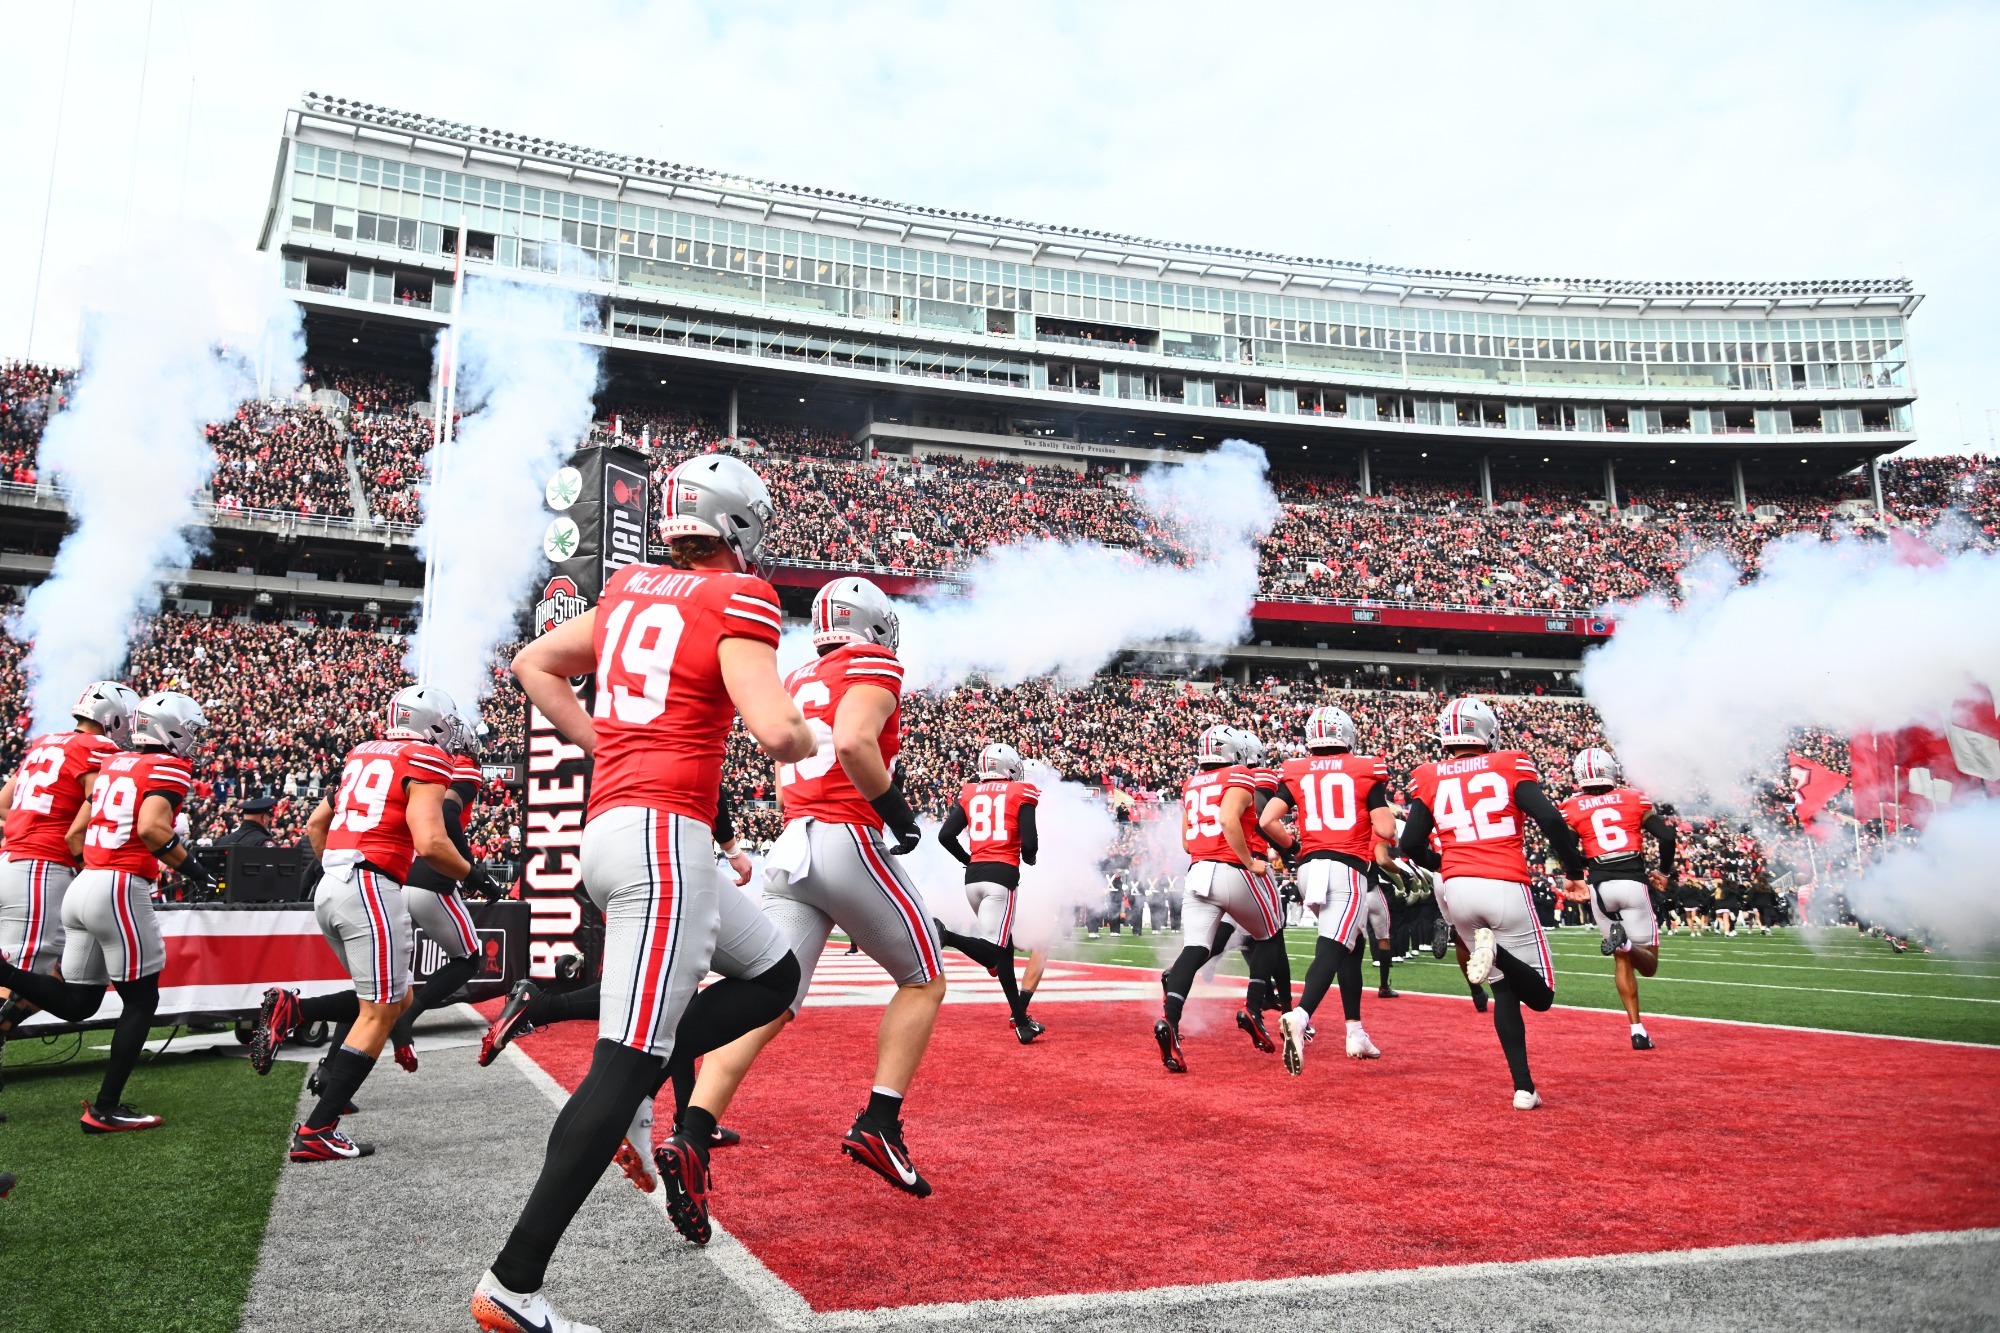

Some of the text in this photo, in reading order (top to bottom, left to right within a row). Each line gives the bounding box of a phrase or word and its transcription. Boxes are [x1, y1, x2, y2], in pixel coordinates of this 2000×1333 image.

[1023, 439, 1116, 454] The Shelly Family Pressbox
[603, 509, 642, 571] ber
[623, 571, 708, 597] McLARTY
[535, 600, 555, 637] OHIO
[593, 600, 686, 725] 19
[11, 746, 66, 815] 62
[975, 782, 1009, 793] WITTEN
[1309, 759, 1343, 772] SAYIN
[1437, 756, 1489, 777] McGUIRE
[84, 774, 138, 850] 29
[969, 793, 1008, 841] 81
[1184, 784, 1223, 841] 35
[1300, 772, 1357, 831] 10
[1433, 771, 1517, 842] 42
[1578, 793, 1623, 811] SANCHEZ
[1590, 807, 1629, 852] 6
